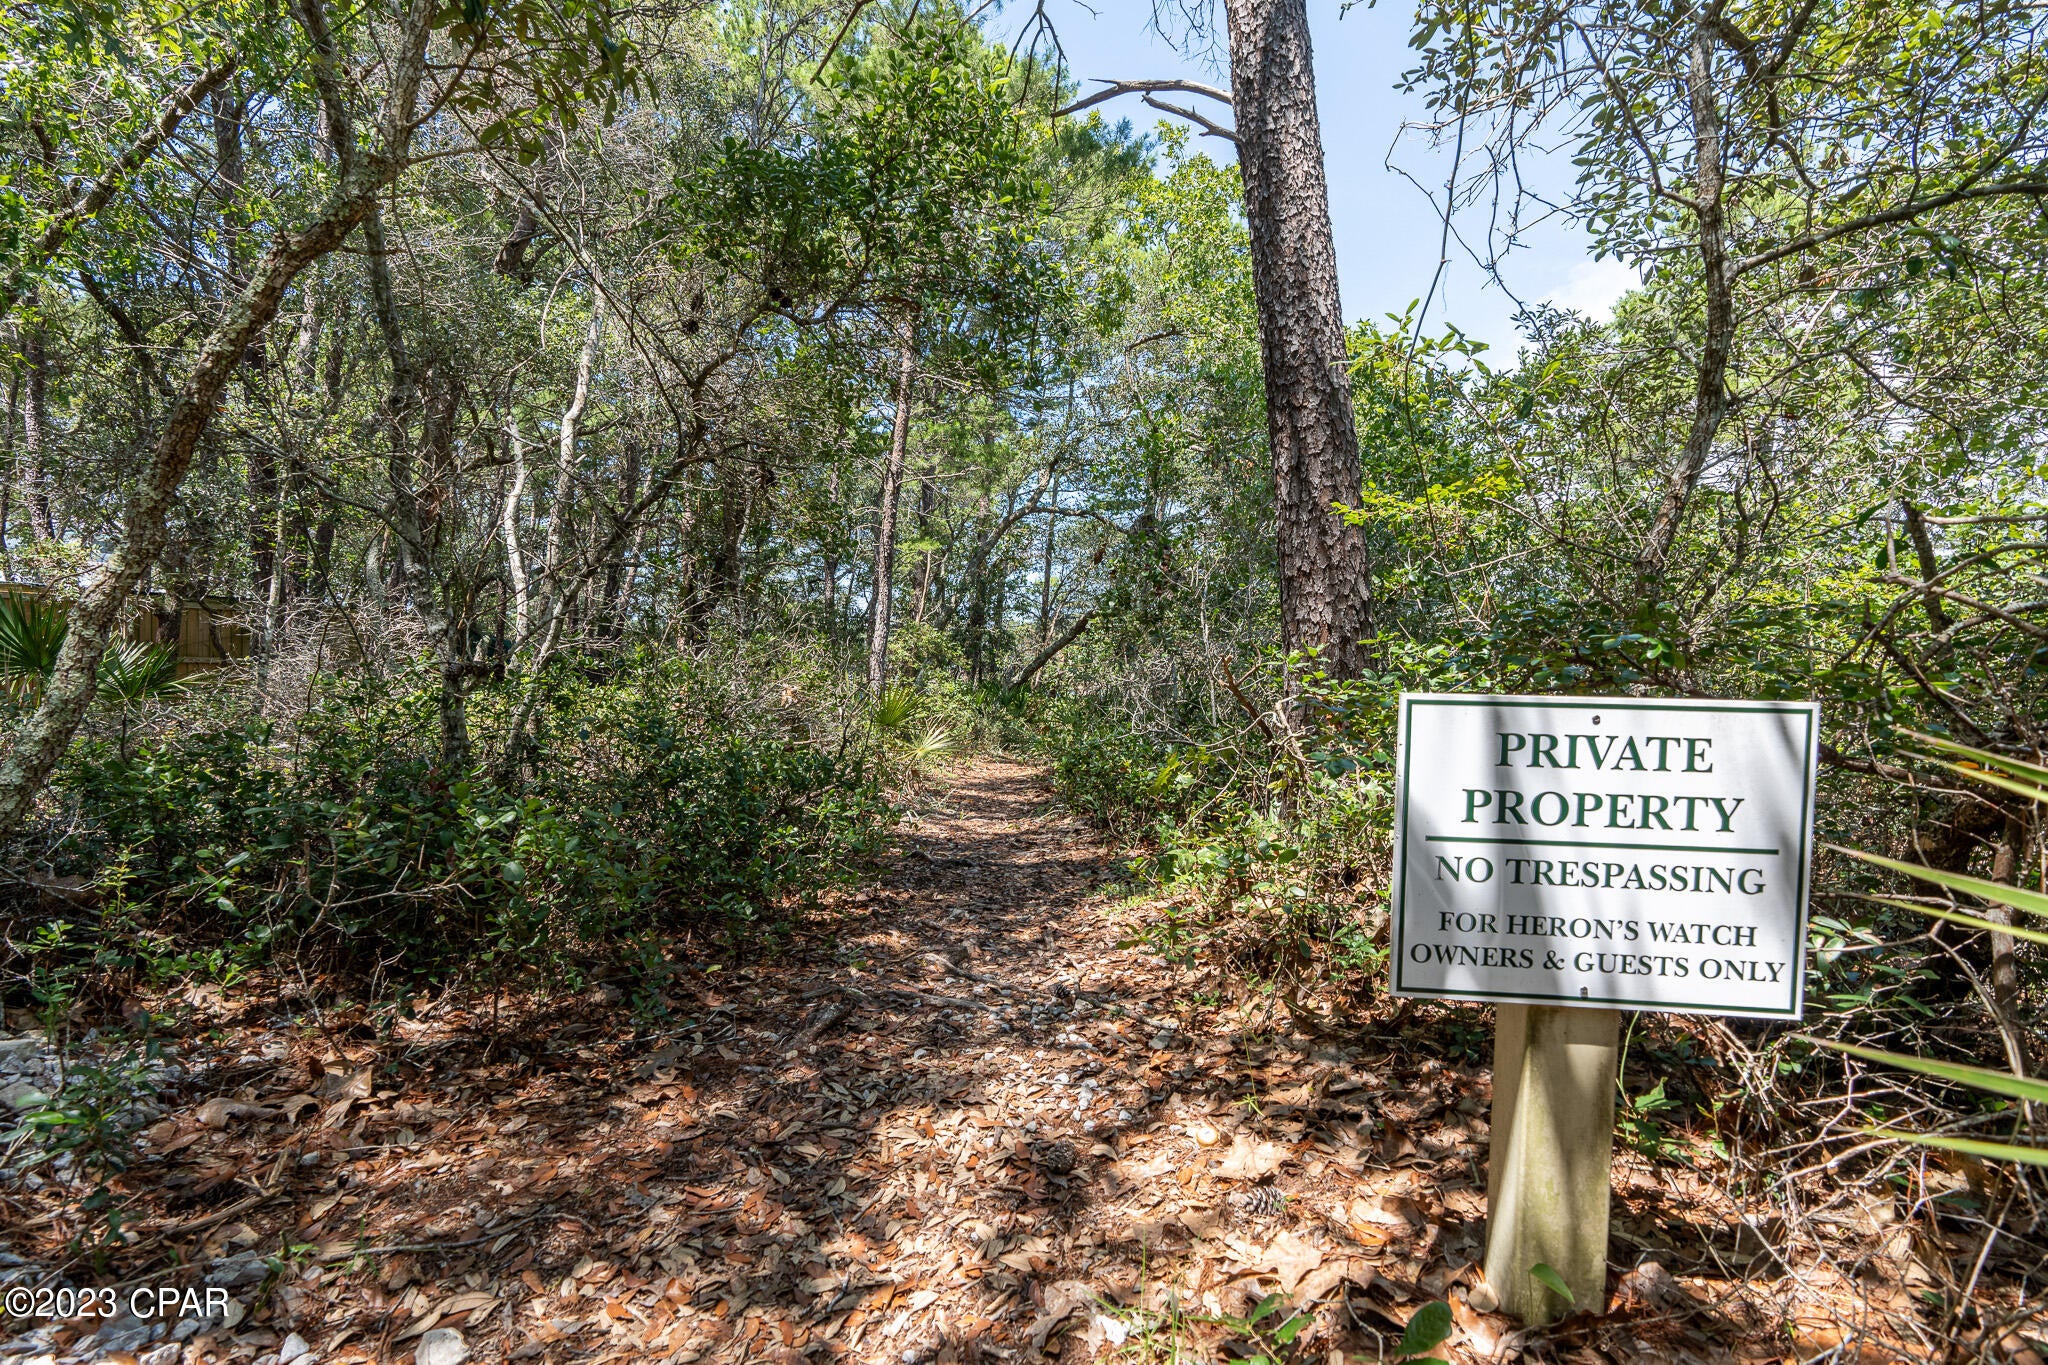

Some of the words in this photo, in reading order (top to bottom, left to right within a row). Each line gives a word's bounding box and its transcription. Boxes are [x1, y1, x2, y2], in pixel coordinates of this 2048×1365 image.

[1495, 732, 1714, 773] PRIVATE
[1461, 788, 1745, 832] PROPERTY
[1435, 855, 1494, 883] NO
[1505, 857, 1766, 895] TRESPASSING
[1438, 911, 1498, 934] FOR
[1506, 915, 1639, 941] HERON'S
[1648, 921, 1758, 947] WATCH
[1410, 943, 1534, 968] OWNERS
[1542, 950, 1565, 970] &
[1573, 951, 1689, 977] GUESTS
[1699, 958, 1786, 983] ONLY
